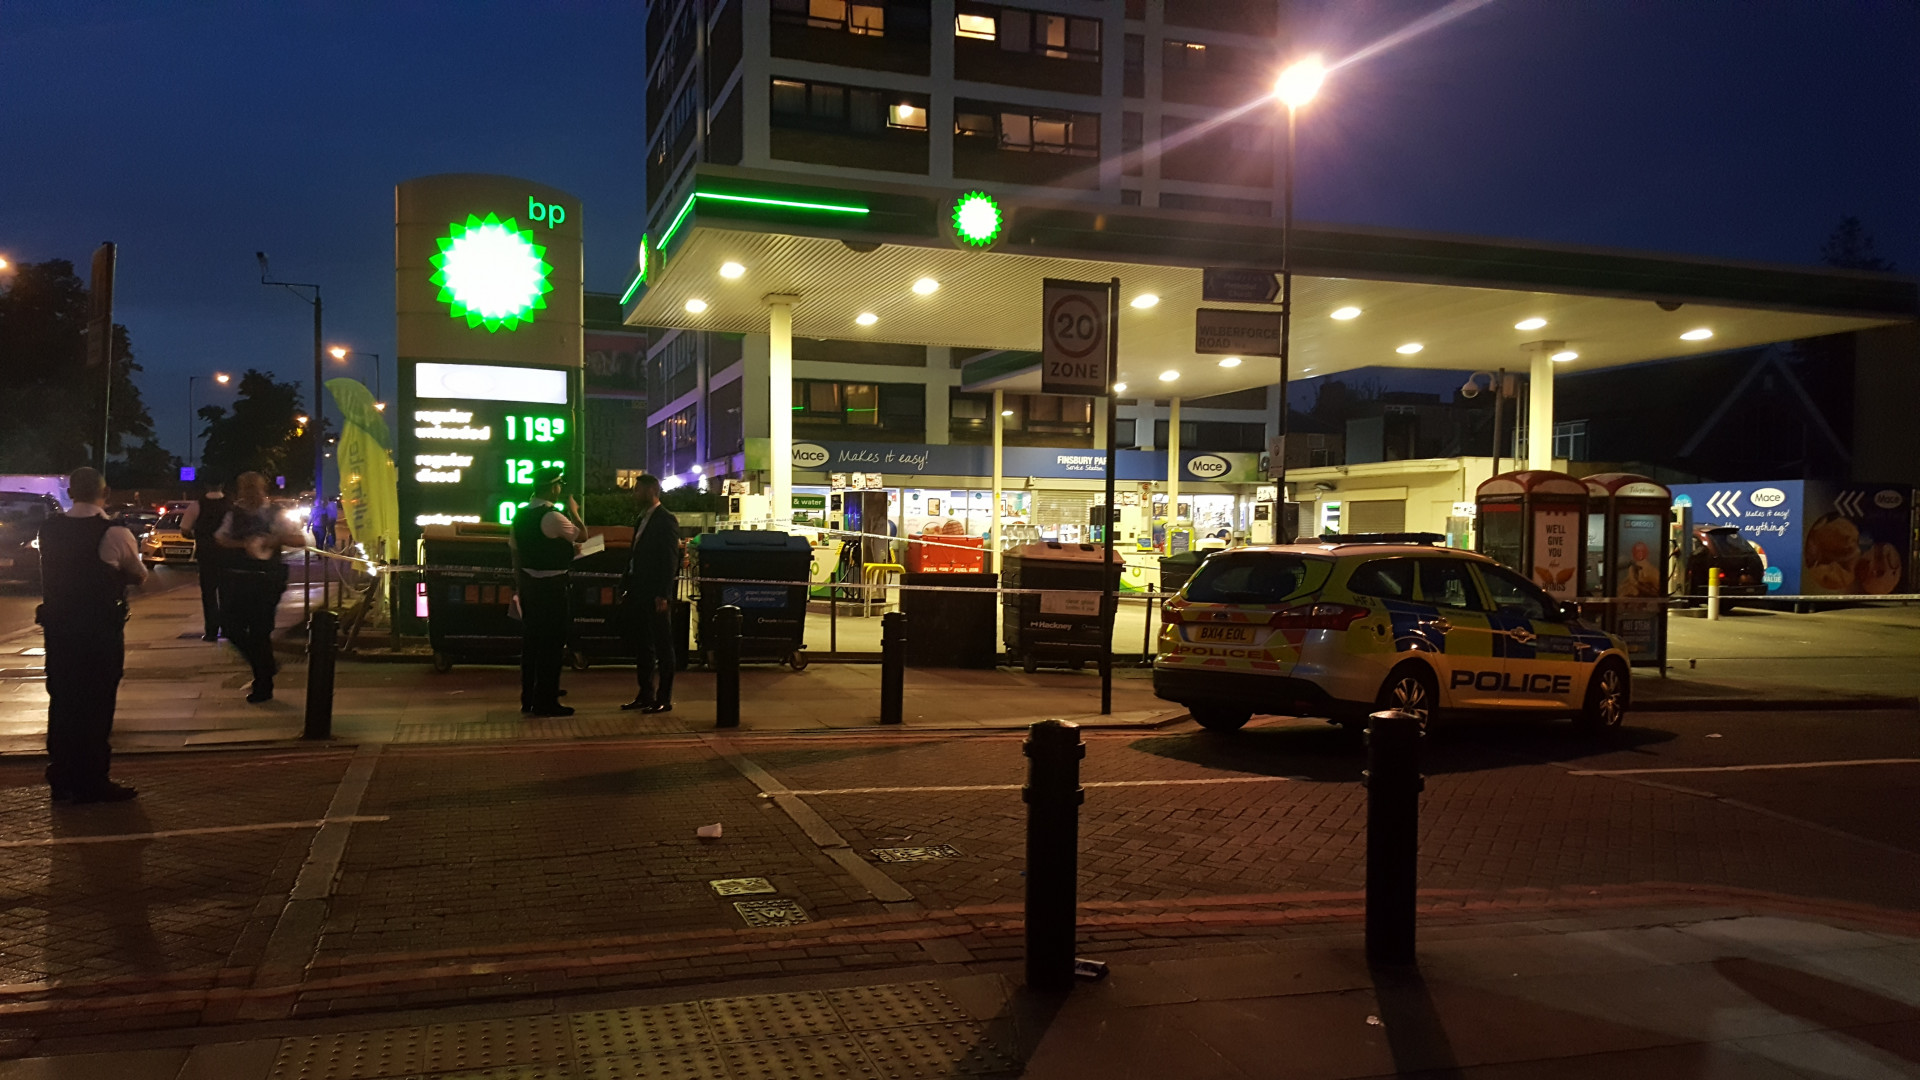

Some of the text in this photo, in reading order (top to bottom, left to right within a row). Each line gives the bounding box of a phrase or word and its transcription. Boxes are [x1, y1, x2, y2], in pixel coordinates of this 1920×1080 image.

[529, 196, 565, 228] bp
[1057, 313, 1094, 340] 20
[1200, 326, 1279, 339] WILBERFORCE
[1199, 337, 1231, 348] ROAD
[1051, 362, 1099, 379] ZONE
[792, 449, 825, 461] Mace
[838, 449, 929, 470] Makes it easy!
[1057, 455, 1093, 465] FINSBURY
[1192, 461, 1223, 472] Mace
[1754, 493, 1781, 502] Mace
[1546, 524, 1566, 534] WE'LL
[1744, 521, 1790, 537] anything?
[1547, 536, 1563, 546] GIVE
[1548, 548, 1562, 558] YOU
[1038, 621, 1073, 632] Hackney
[1201, 626, 1247, 641] BX14 EOL
[1180, 646, 1261, 659] POLICE
[1451, 670, 1572, 694] POLICE
